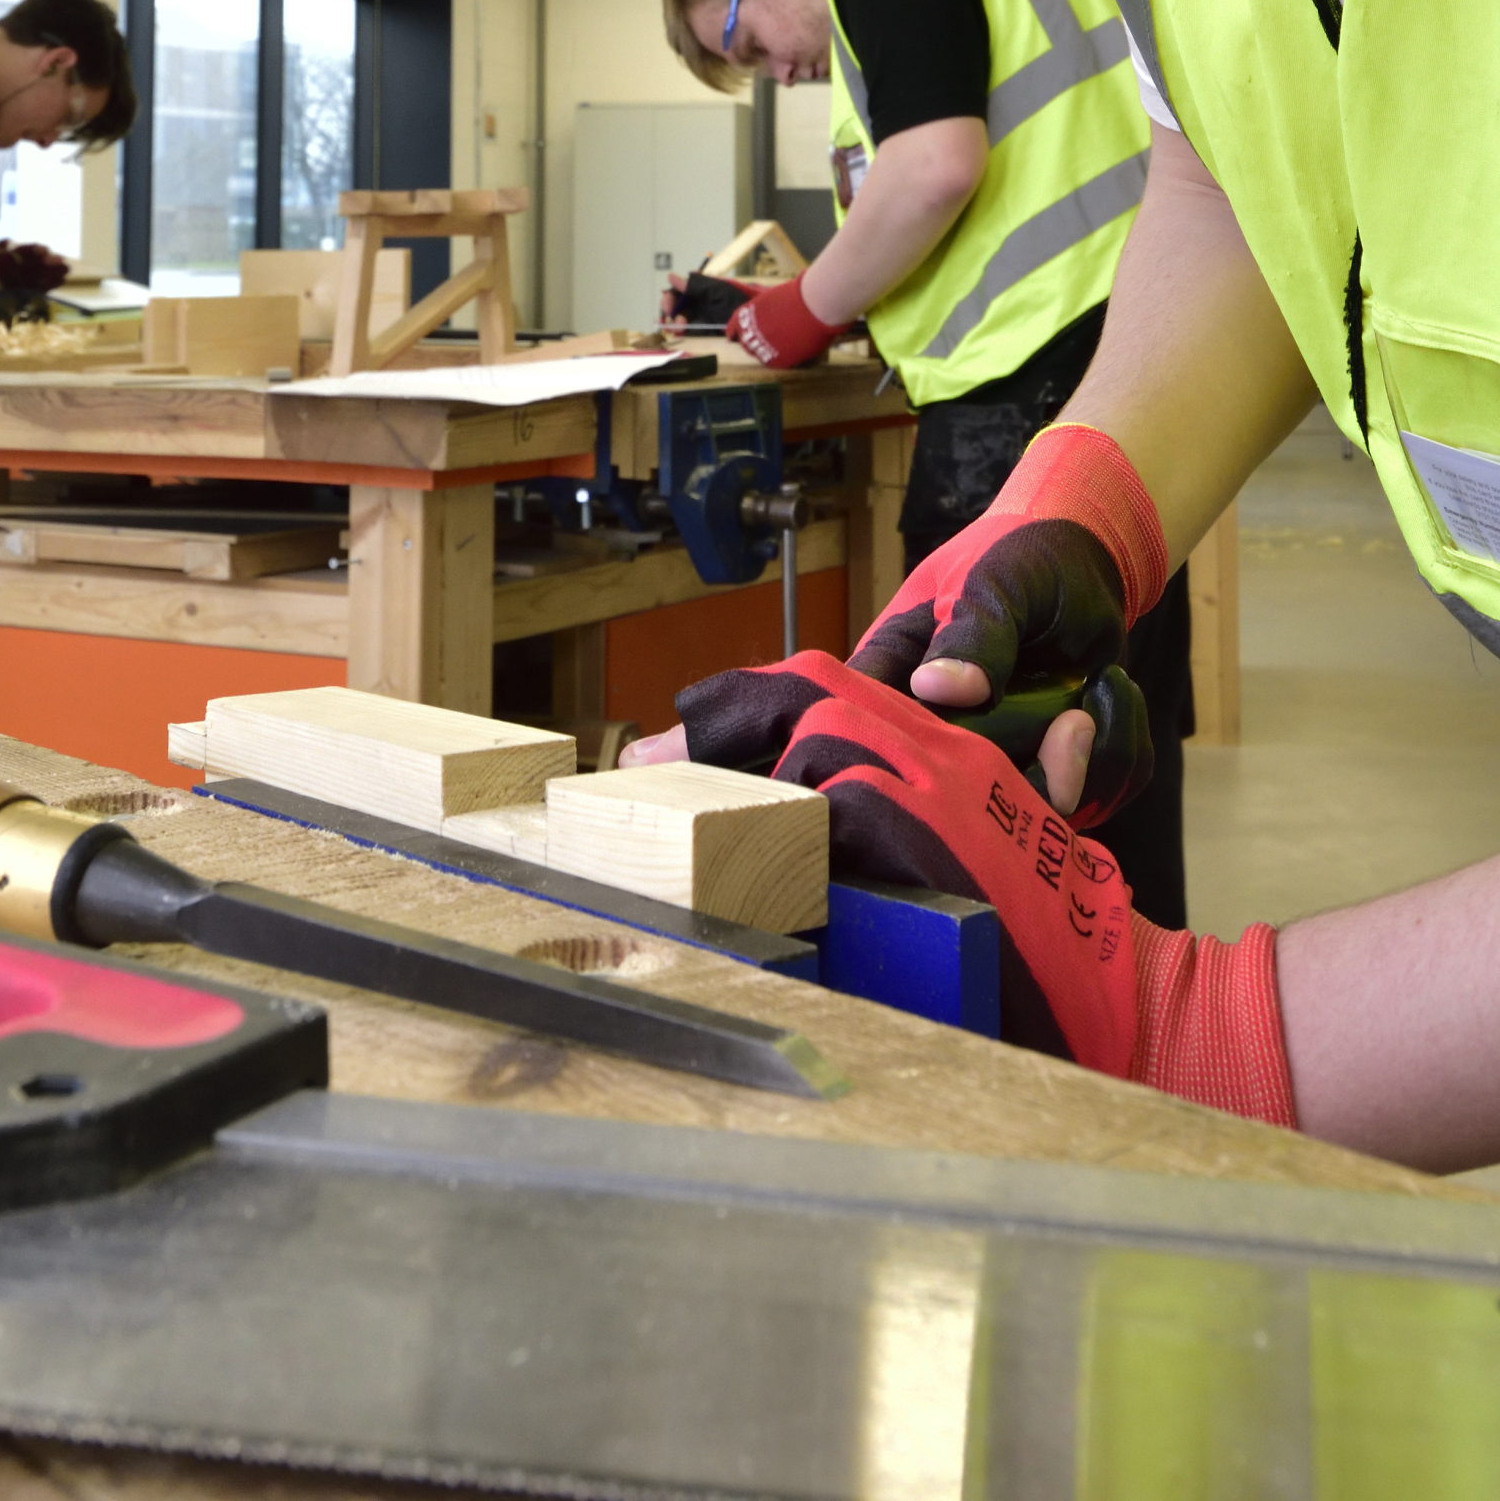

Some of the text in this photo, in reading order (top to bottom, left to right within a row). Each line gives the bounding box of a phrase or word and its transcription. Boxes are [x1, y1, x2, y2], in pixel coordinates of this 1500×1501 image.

[1035, 816, 1070, 892] RED
[1099, 905, 1125, 962] SIZE 10
